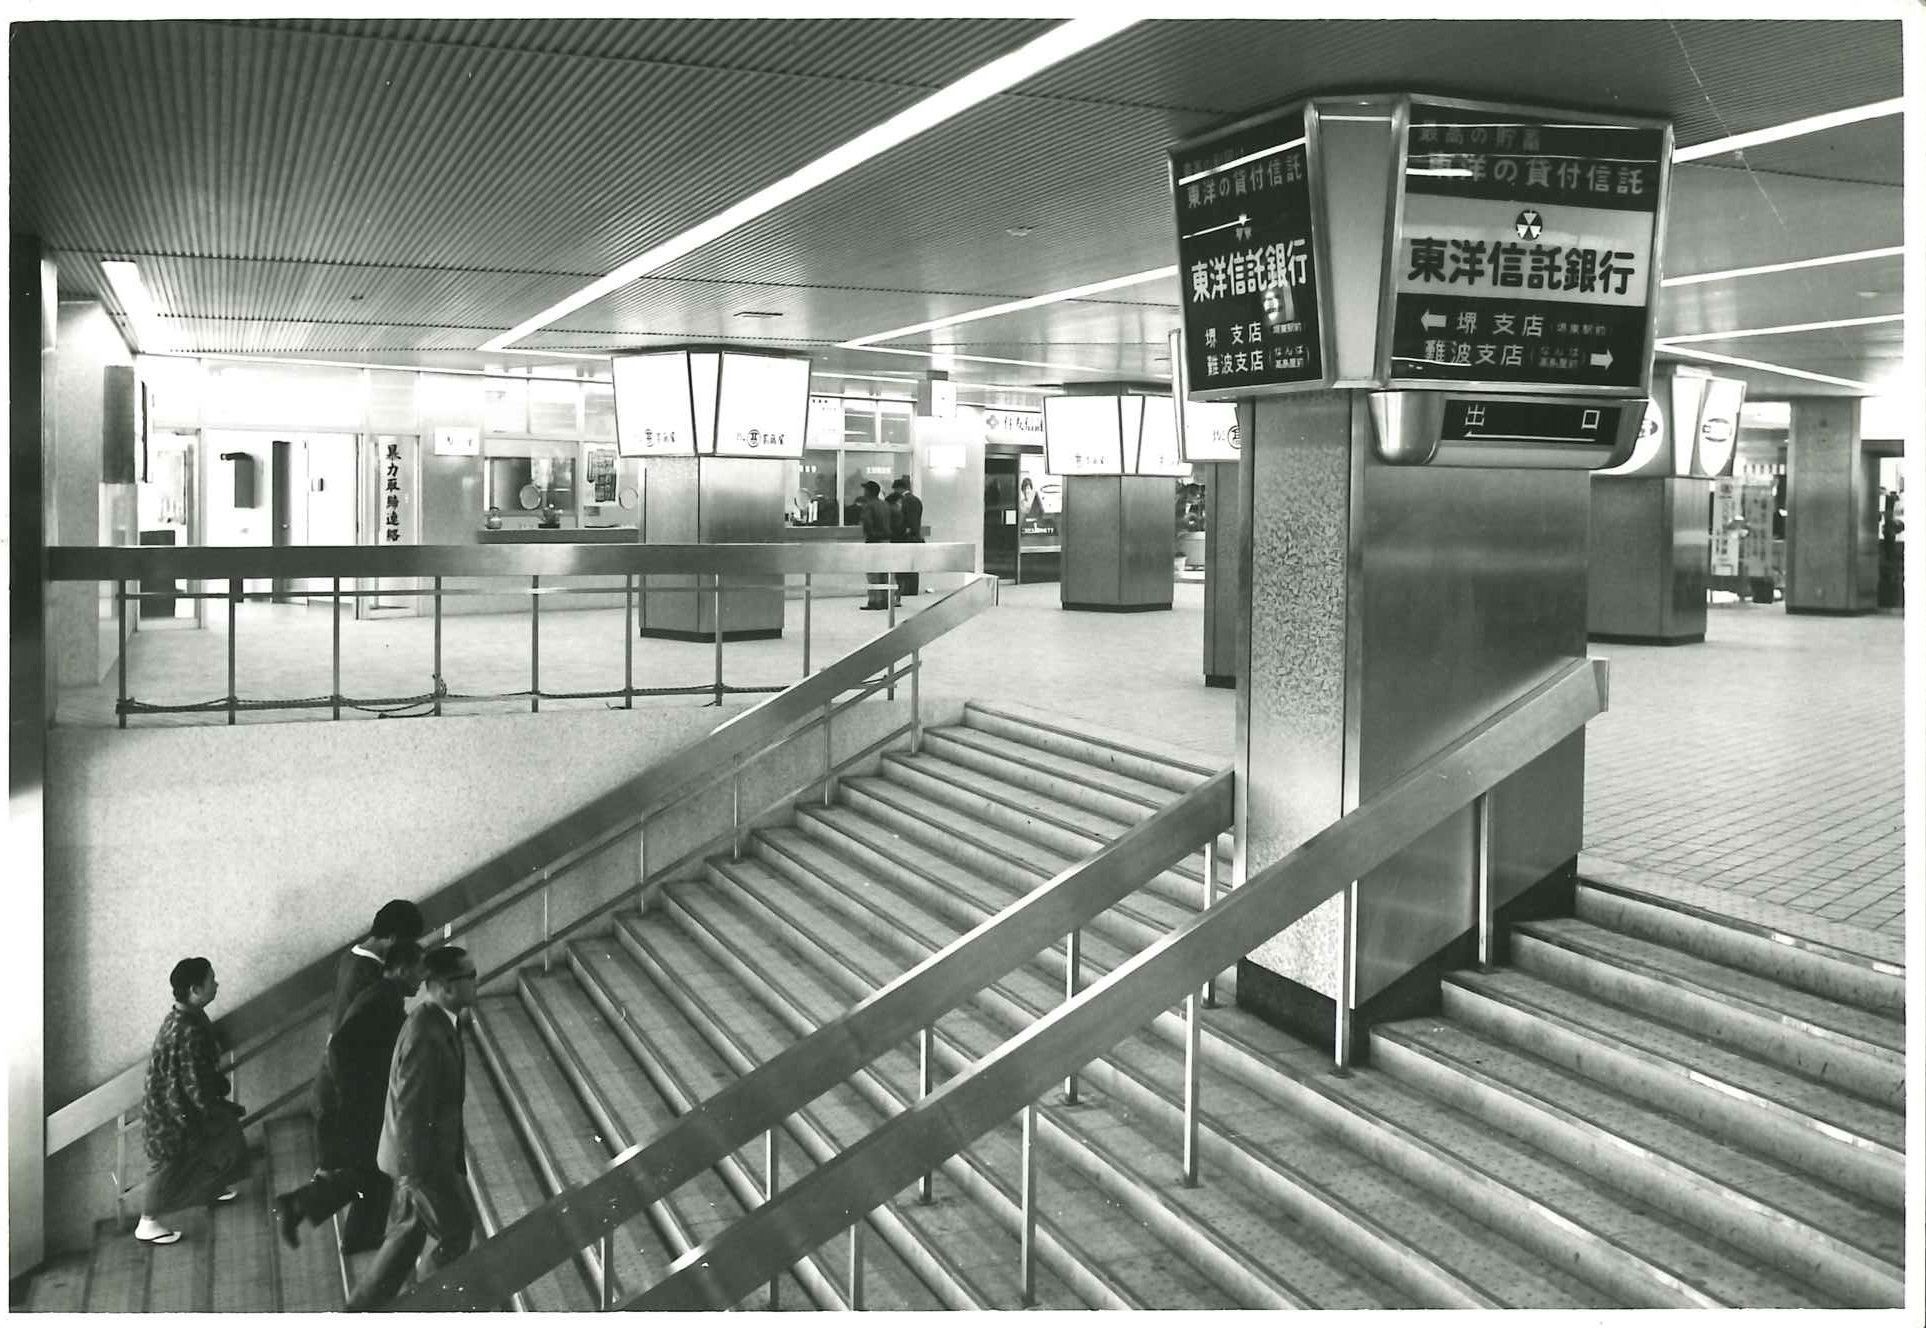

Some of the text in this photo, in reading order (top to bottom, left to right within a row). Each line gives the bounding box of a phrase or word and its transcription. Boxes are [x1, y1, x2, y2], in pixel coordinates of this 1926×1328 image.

[1187, 154, 1302, 208] 東洋の貸付信託
[1191, 239, 1308, 303] 東洋信託銀行
[1408, 237, 1635, 295] 東洋信託銀行
[1206, 350, 1264, 376] 難波支店
[1425, 340, 1524, 367] 難波支店
[1464, 404, 1601, 429] 出口
